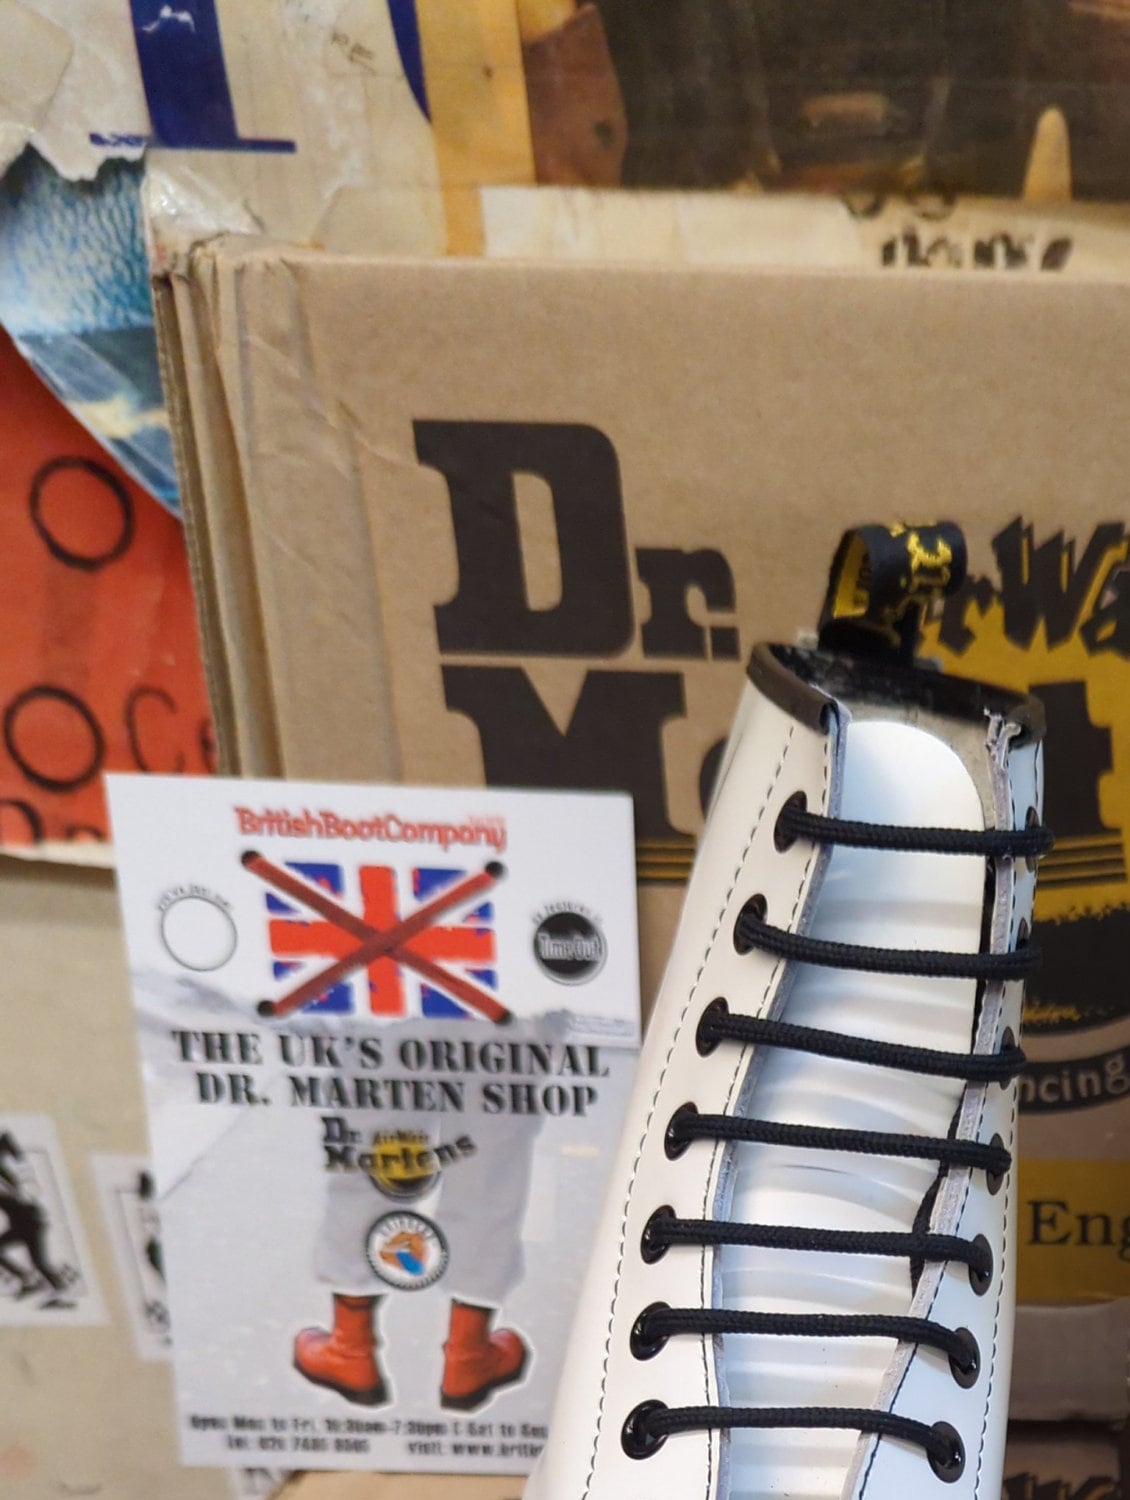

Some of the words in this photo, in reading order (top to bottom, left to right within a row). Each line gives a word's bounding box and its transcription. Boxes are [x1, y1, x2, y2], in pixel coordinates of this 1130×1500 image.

[412, 419, 740, 661] Dr.
[235, 806, 507, 852] BritishBootCompany
[173, 1031, 262, 1065] THE
[279, 1034, 383, 1069] UK'S
[400, 1039, 609, 1078] ORIGINAL
[197, 1072, 270, 1105] DR.
[289, 1076, 464, 1113] MARTEN
[483, 1082, 598, 1117] SHOP
[323, 1134, 478, 1173] Martens
